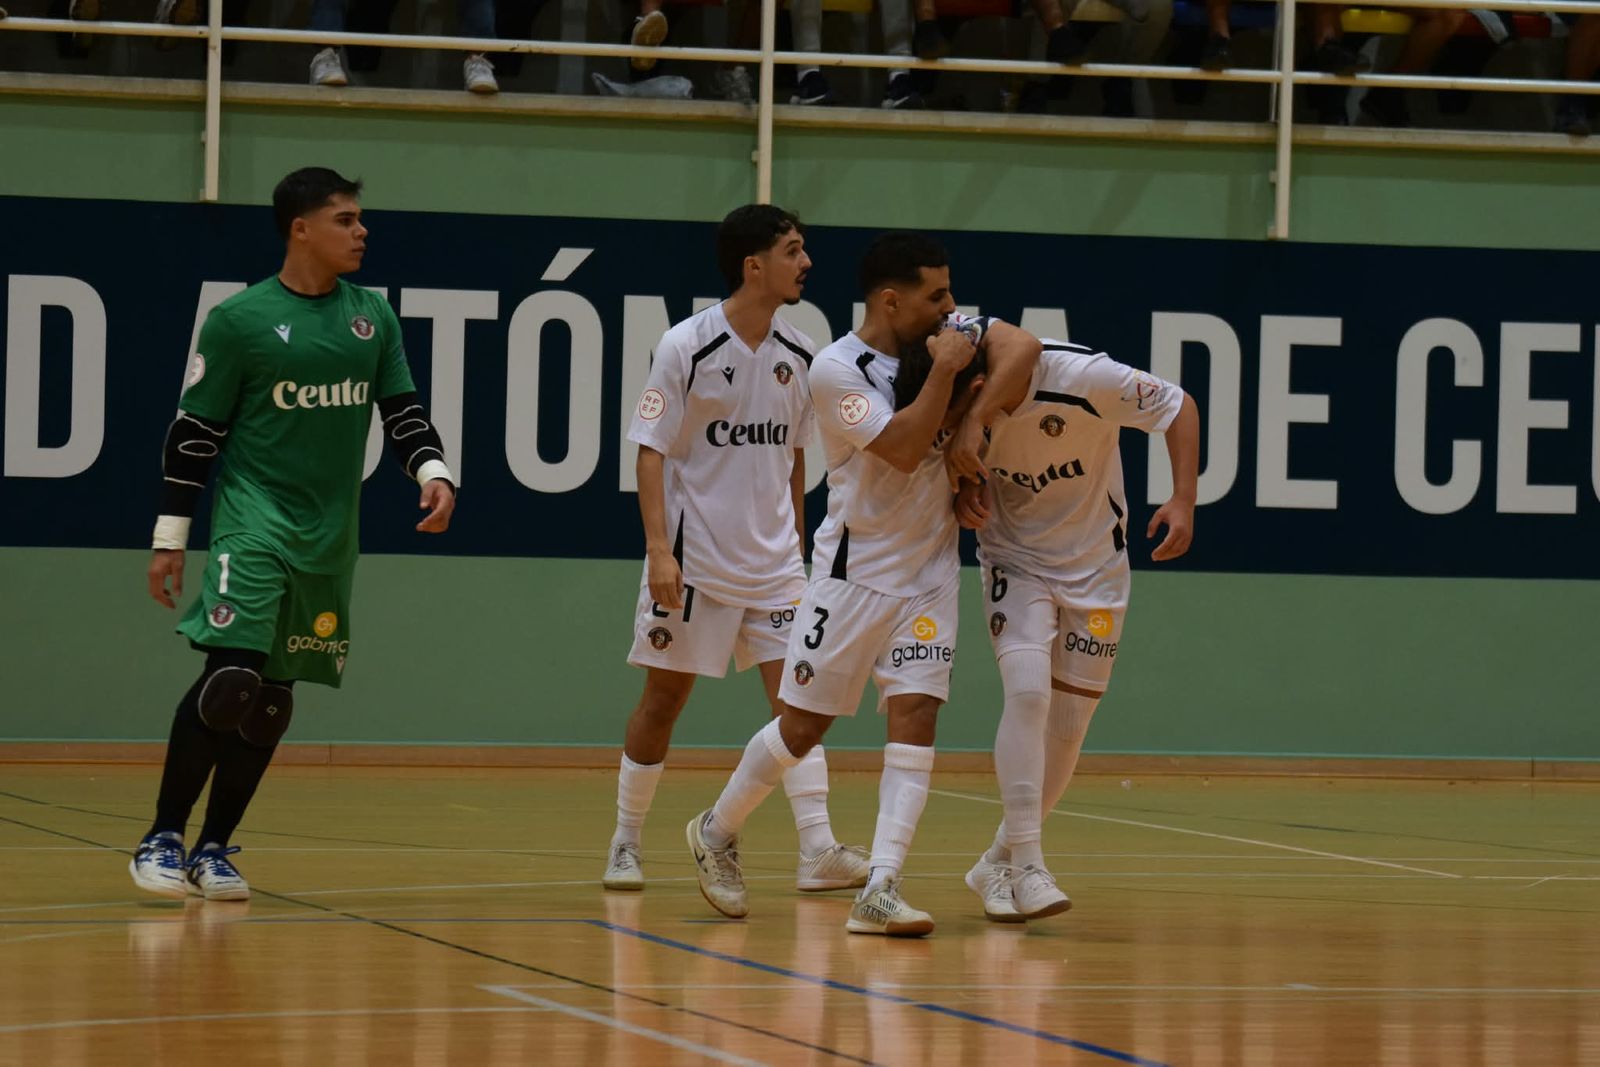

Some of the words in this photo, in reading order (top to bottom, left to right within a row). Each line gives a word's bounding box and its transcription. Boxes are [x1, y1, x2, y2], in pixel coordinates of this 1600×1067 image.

[273, 377, 369, 410] Ceuta
[1147, 311, 1342, 510] DE
[1394, 317, 1600, 515] CE
[706, 418, 788, 447] Ceuta
[217, 553, 230, 594] 1
[991, 565, 1008, 603] 6
[804, 606, 829, 649] 3
